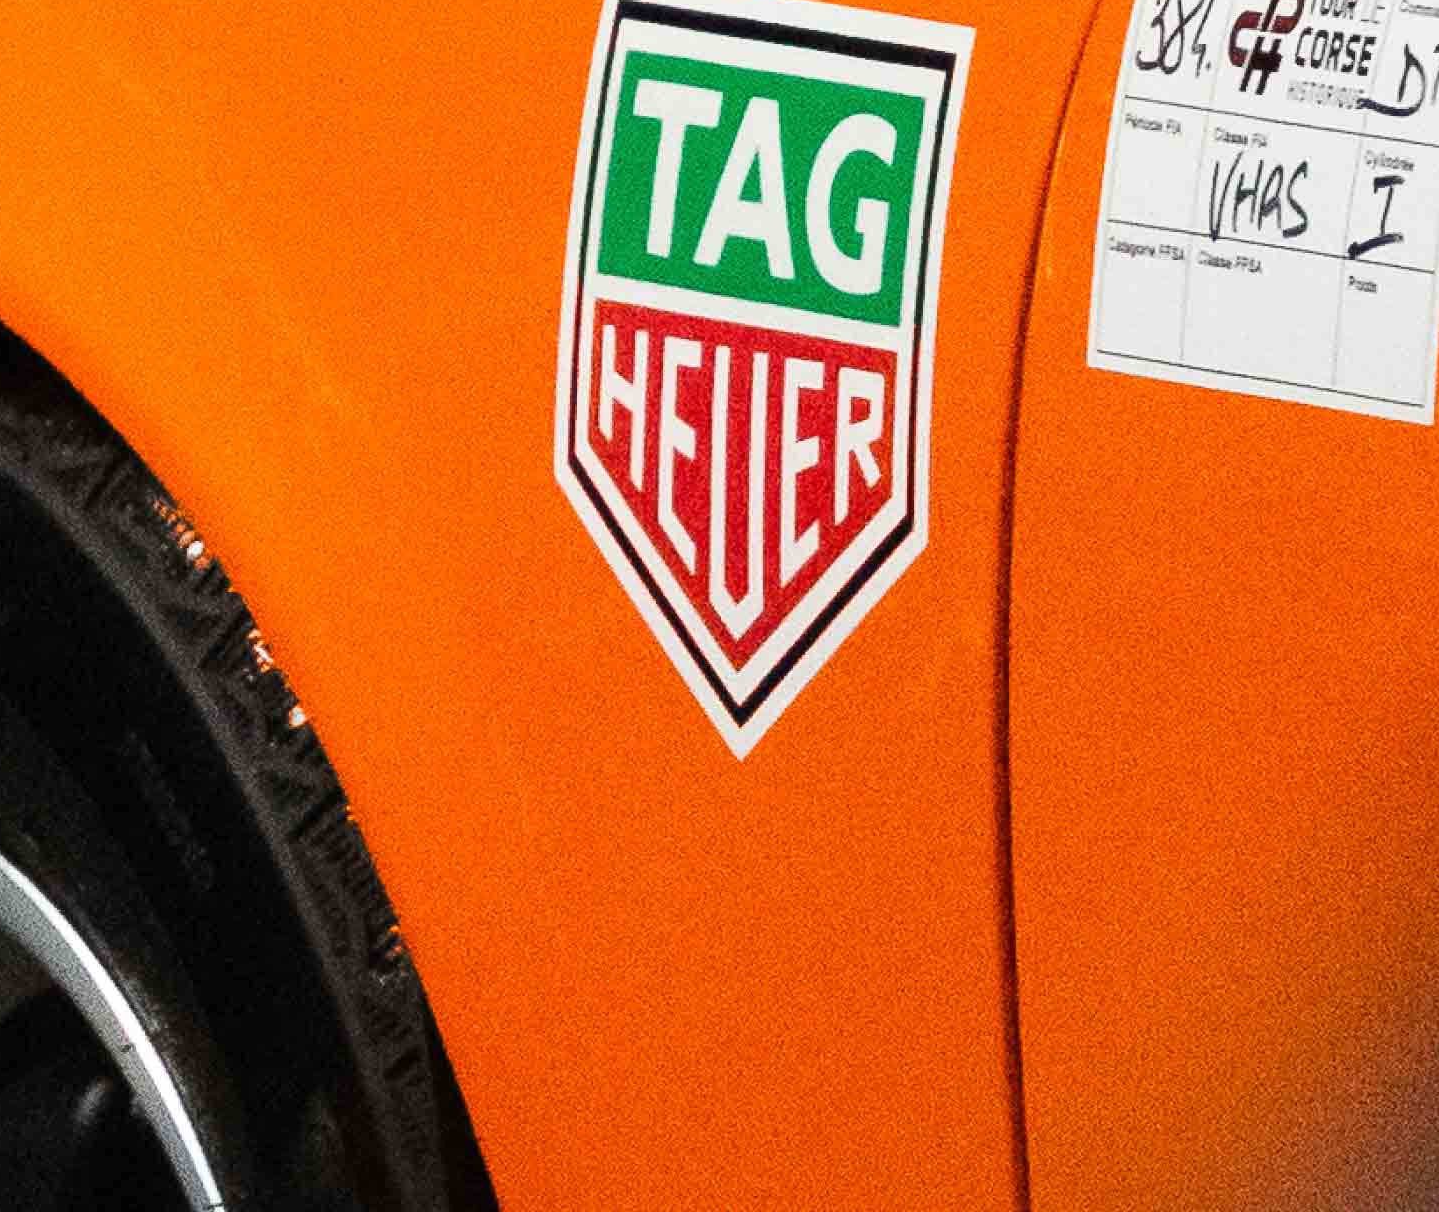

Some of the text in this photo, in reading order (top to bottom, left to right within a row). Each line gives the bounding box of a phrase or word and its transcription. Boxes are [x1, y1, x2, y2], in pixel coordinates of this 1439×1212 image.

[1295, 25, 1377, 77] CORSE
[633, 76, 898, 296] TAG
[598, 323, 886, 641] HEUER
